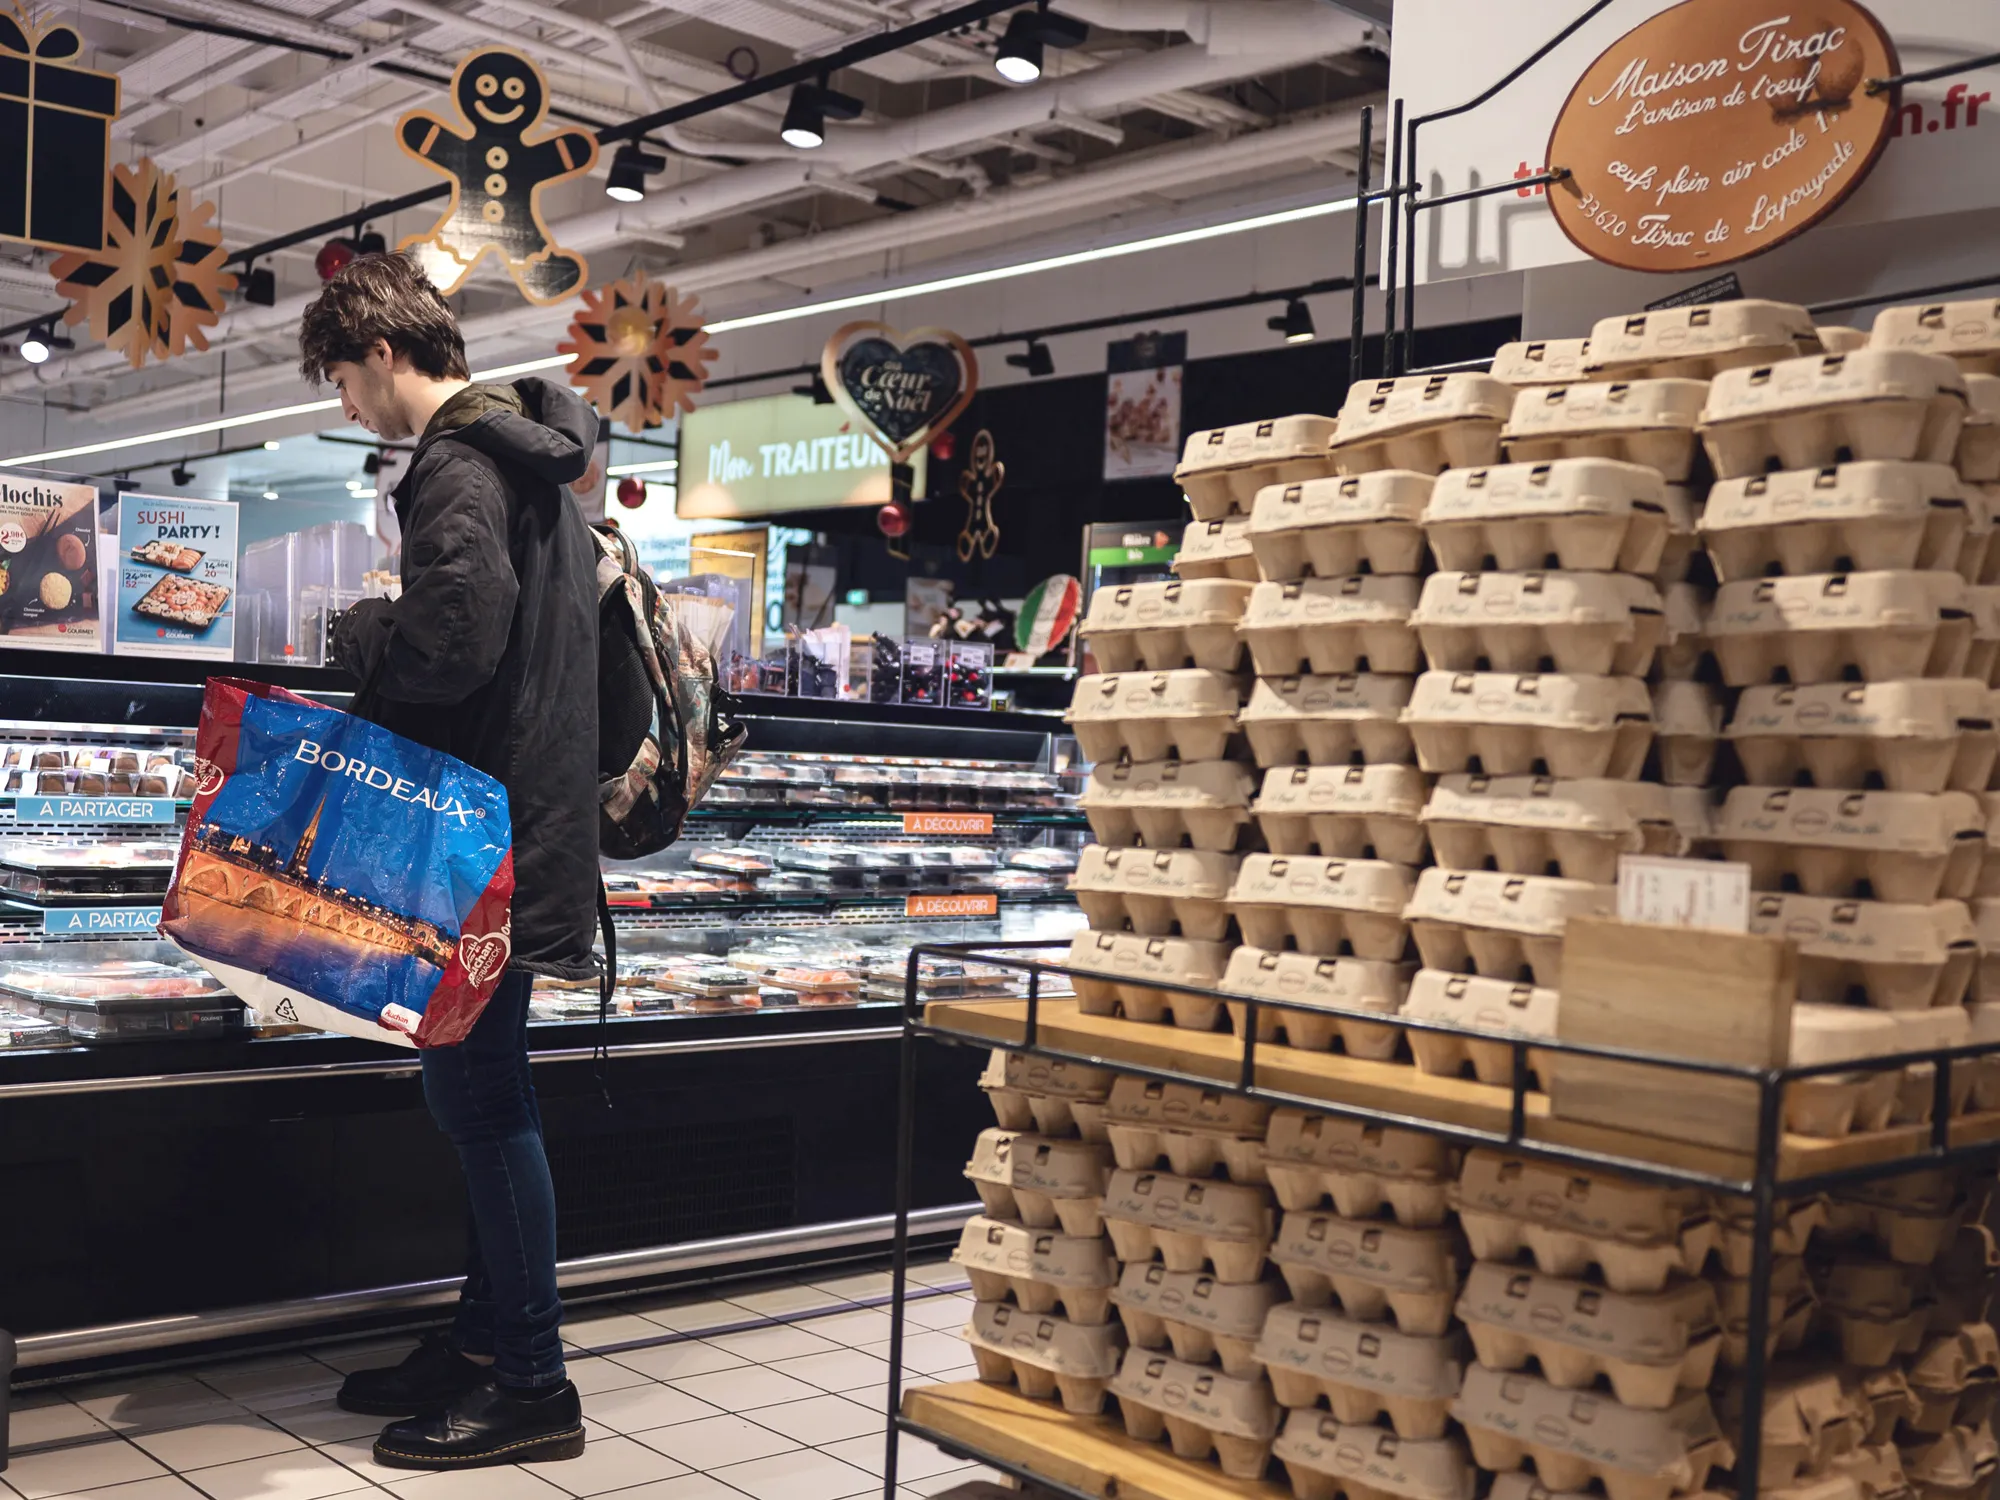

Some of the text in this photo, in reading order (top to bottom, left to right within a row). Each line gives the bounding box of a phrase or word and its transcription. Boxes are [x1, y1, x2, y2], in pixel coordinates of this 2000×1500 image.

[1588, 57, 1729, 106] Maison
[1614, 96, 1717, 136] L'artisan
[1722, 82, 1746, 107] de
[1656, 165, 1710, 207] plein
[1721, 161, 1757, 187] air
[1761, 128, 1808, 170] code
[1577, 192, 1628, 237] 33620
[1704, 218, 1730, 244] de
[1744, 140, 1855, 234] Lapouyade
[137, 511, 185, 525] SUSHI
[204, 569, 217, 578] 20
[40, 801, 154, 817] A PARTAGER
[924, 817, 985, 831] DÉCOUVRIR
[927, 898, 988, 913] DÉCOUVRIR
[68, 913, 83, 928] A
[384, 1008, 409, 1024] Auchan
